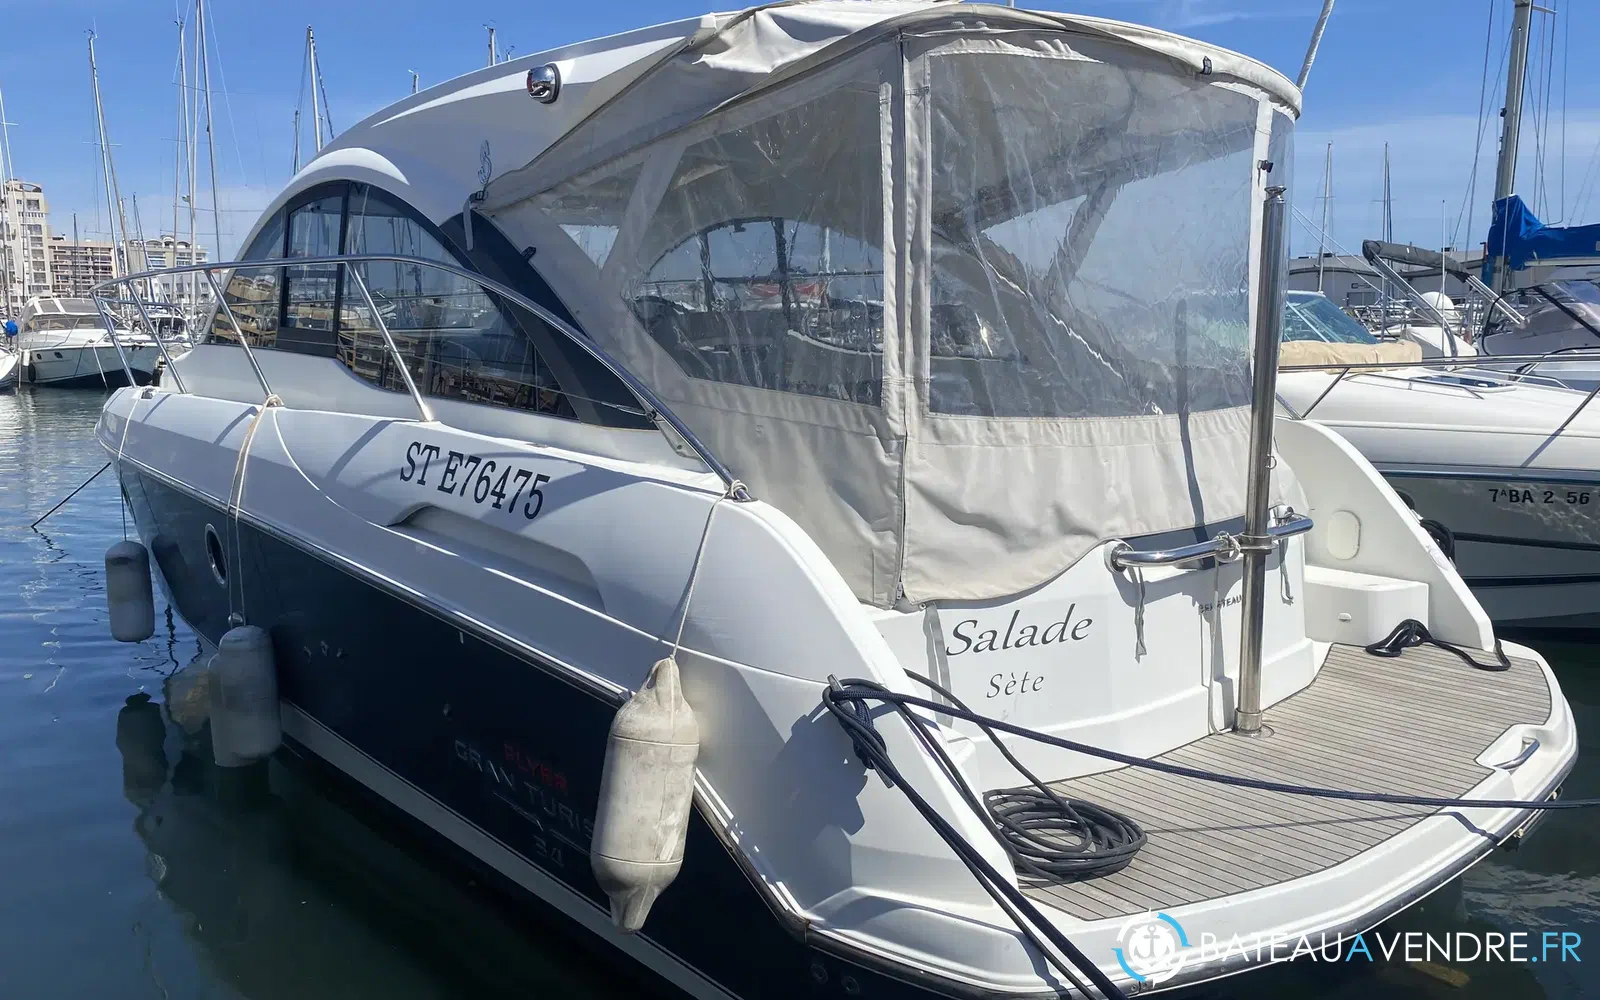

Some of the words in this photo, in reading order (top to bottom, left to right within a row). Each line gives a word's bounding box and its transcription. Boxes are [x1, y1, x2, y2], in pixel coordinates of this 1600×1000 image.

[400, 441, 440, 486] ST
[437, 450, 551, 520] E76475
[1543, 490, 1555, 504] 2
[946, 603, 1093, 656] Salade
[986, 671, 1044, 698] Sète
[523, 780, 593, 840] TURIS
